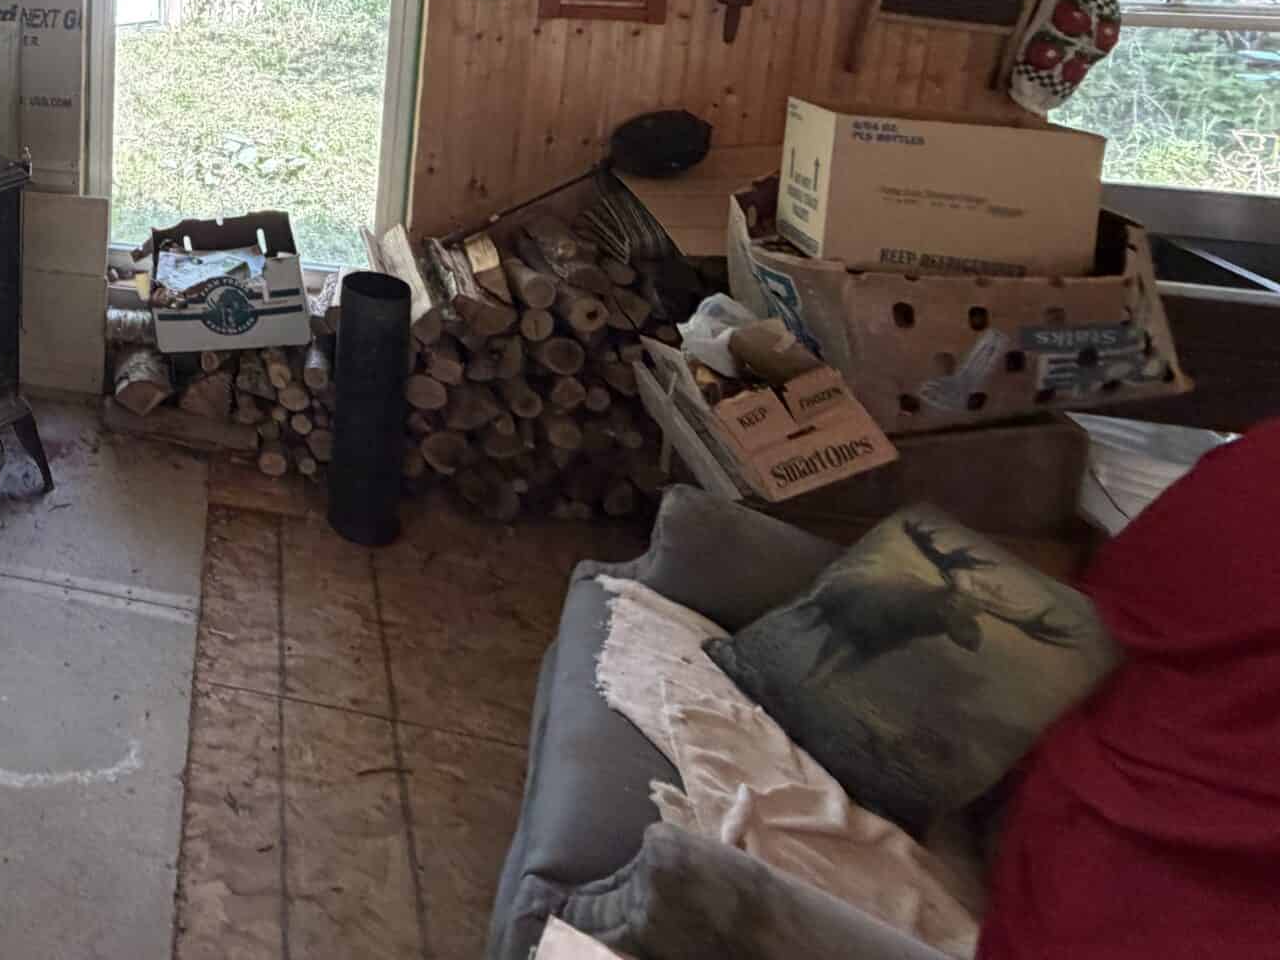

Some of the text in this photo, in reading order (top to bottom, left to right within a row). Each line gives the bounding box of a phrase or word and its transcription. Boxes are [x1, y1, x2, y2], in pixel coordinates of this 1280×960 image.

[20, 6, 59, 30] NEXT
[735, 386, 844, 430] KEEP FROZEN
[770, 436, 875, 489] Smart Ones
